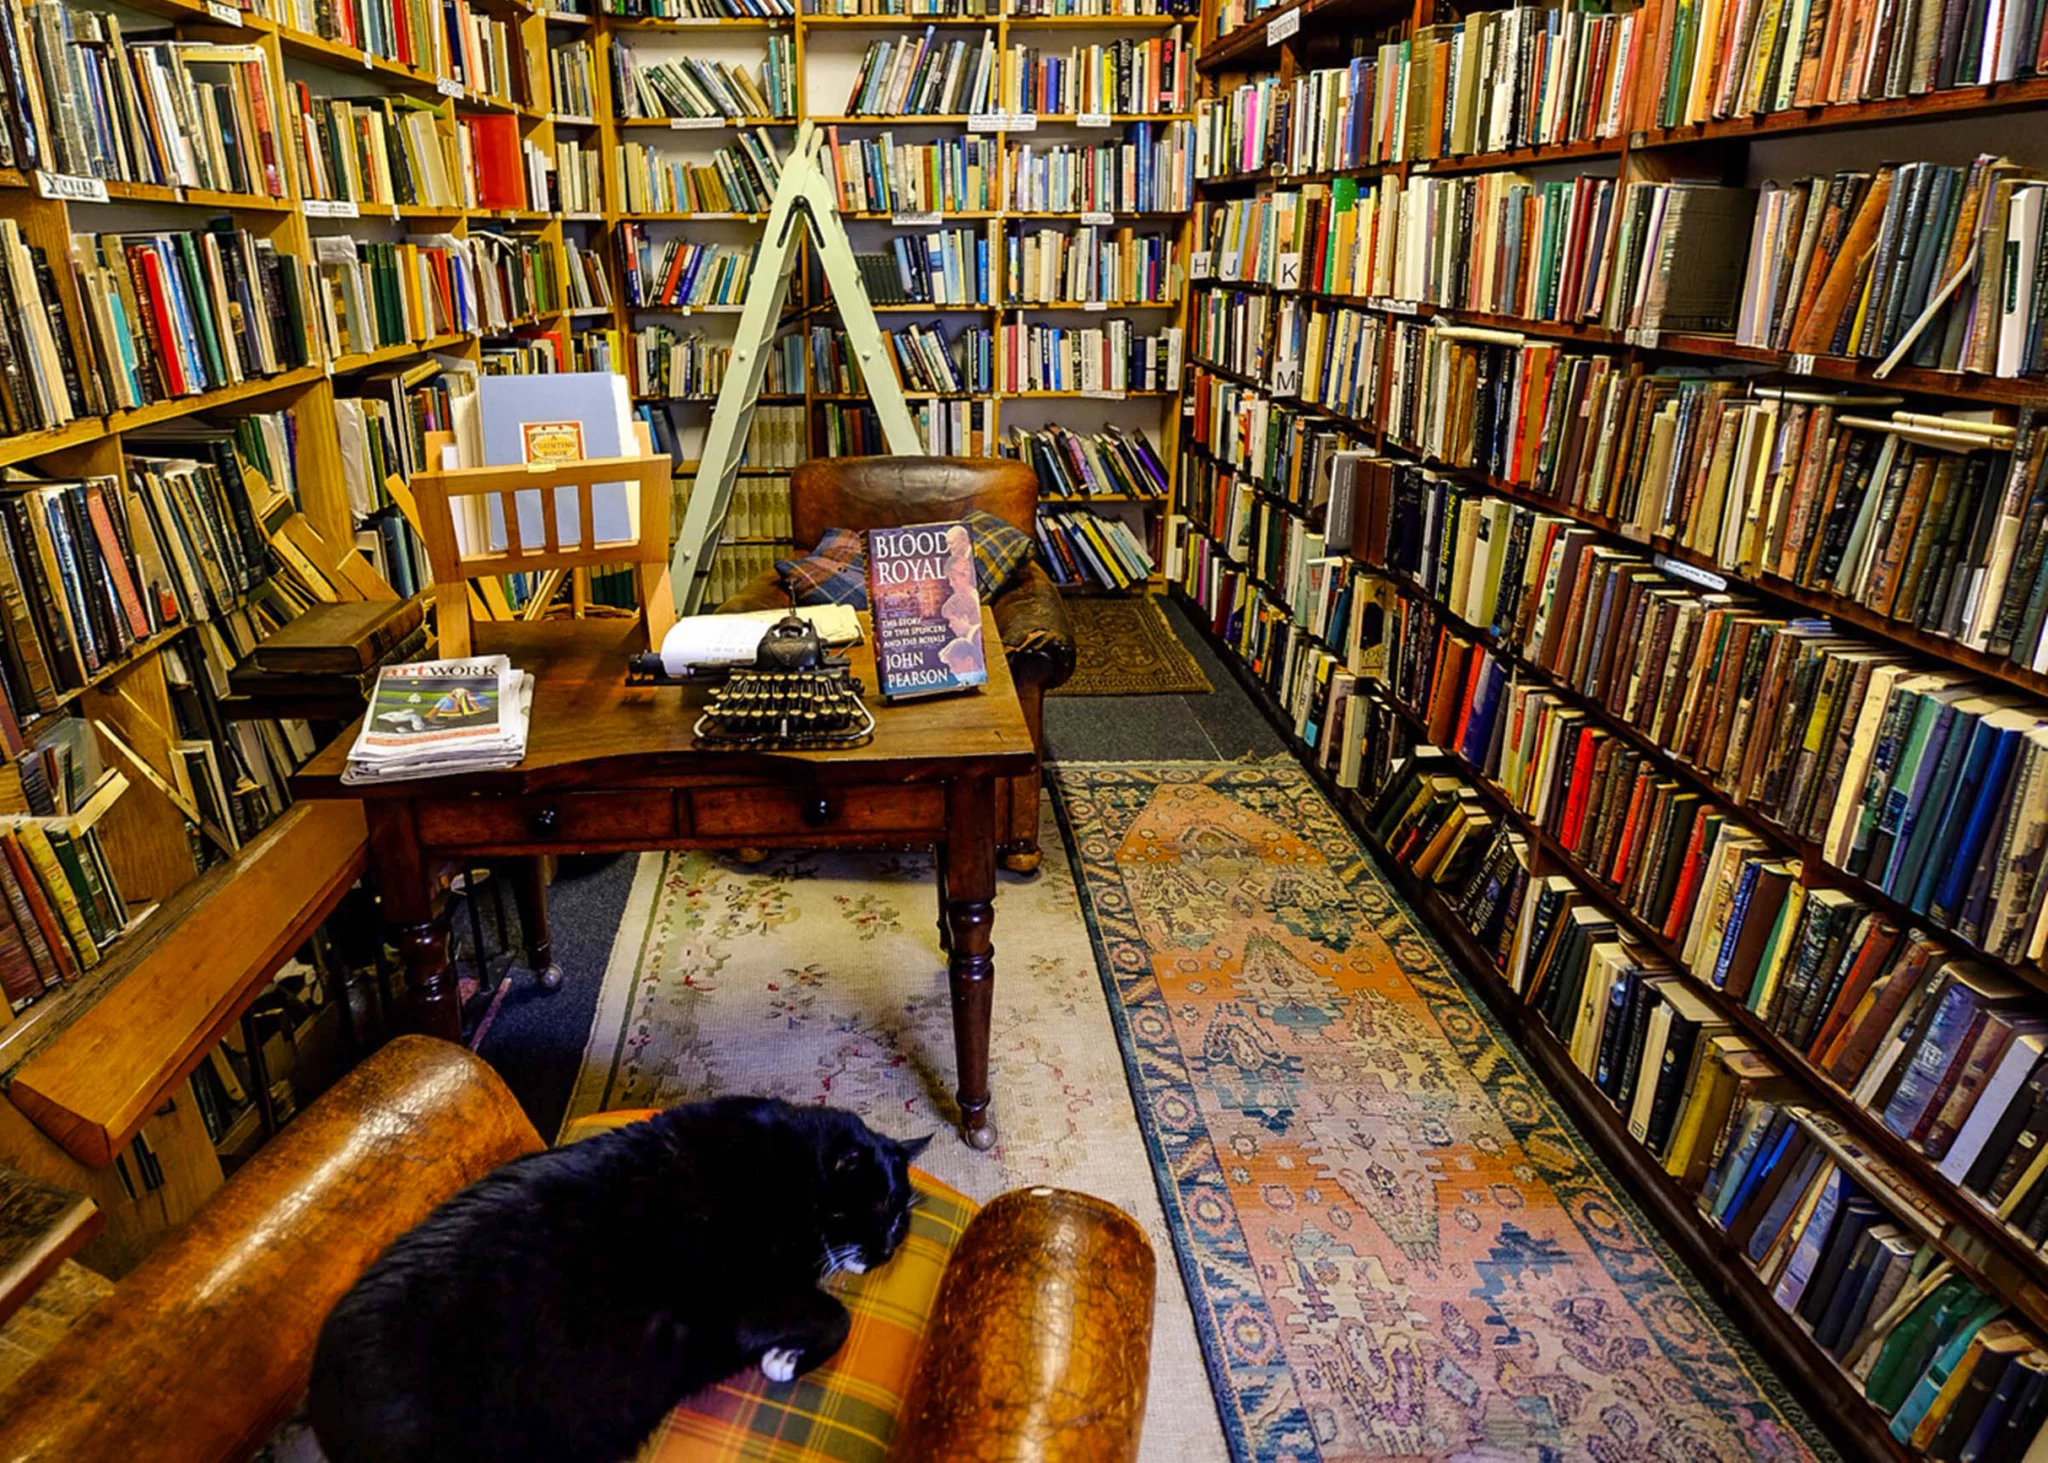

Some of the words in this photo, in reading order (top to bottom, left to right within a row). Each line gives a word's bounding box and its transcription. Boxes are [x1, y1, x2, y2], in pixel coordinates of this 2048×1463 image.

[1194, 258, 1207, 273] H
[1225, 259, 1237, 276] J
[1282, 262, 1298, 283] K
[1276, 370, 1295, 390] M
[875, 531, 950, 559] BLOOD
[876, 557, 947, 585] ROYAL
[898, 617, 921, 626] STORY
[894, 628, 910, 637] THE
[883, 640, 901, 648] AND
[902, 638, 917, 646] THE
[886, 652, 924, 673] JOHN
[887, 668, 948, 689] PEARSON
